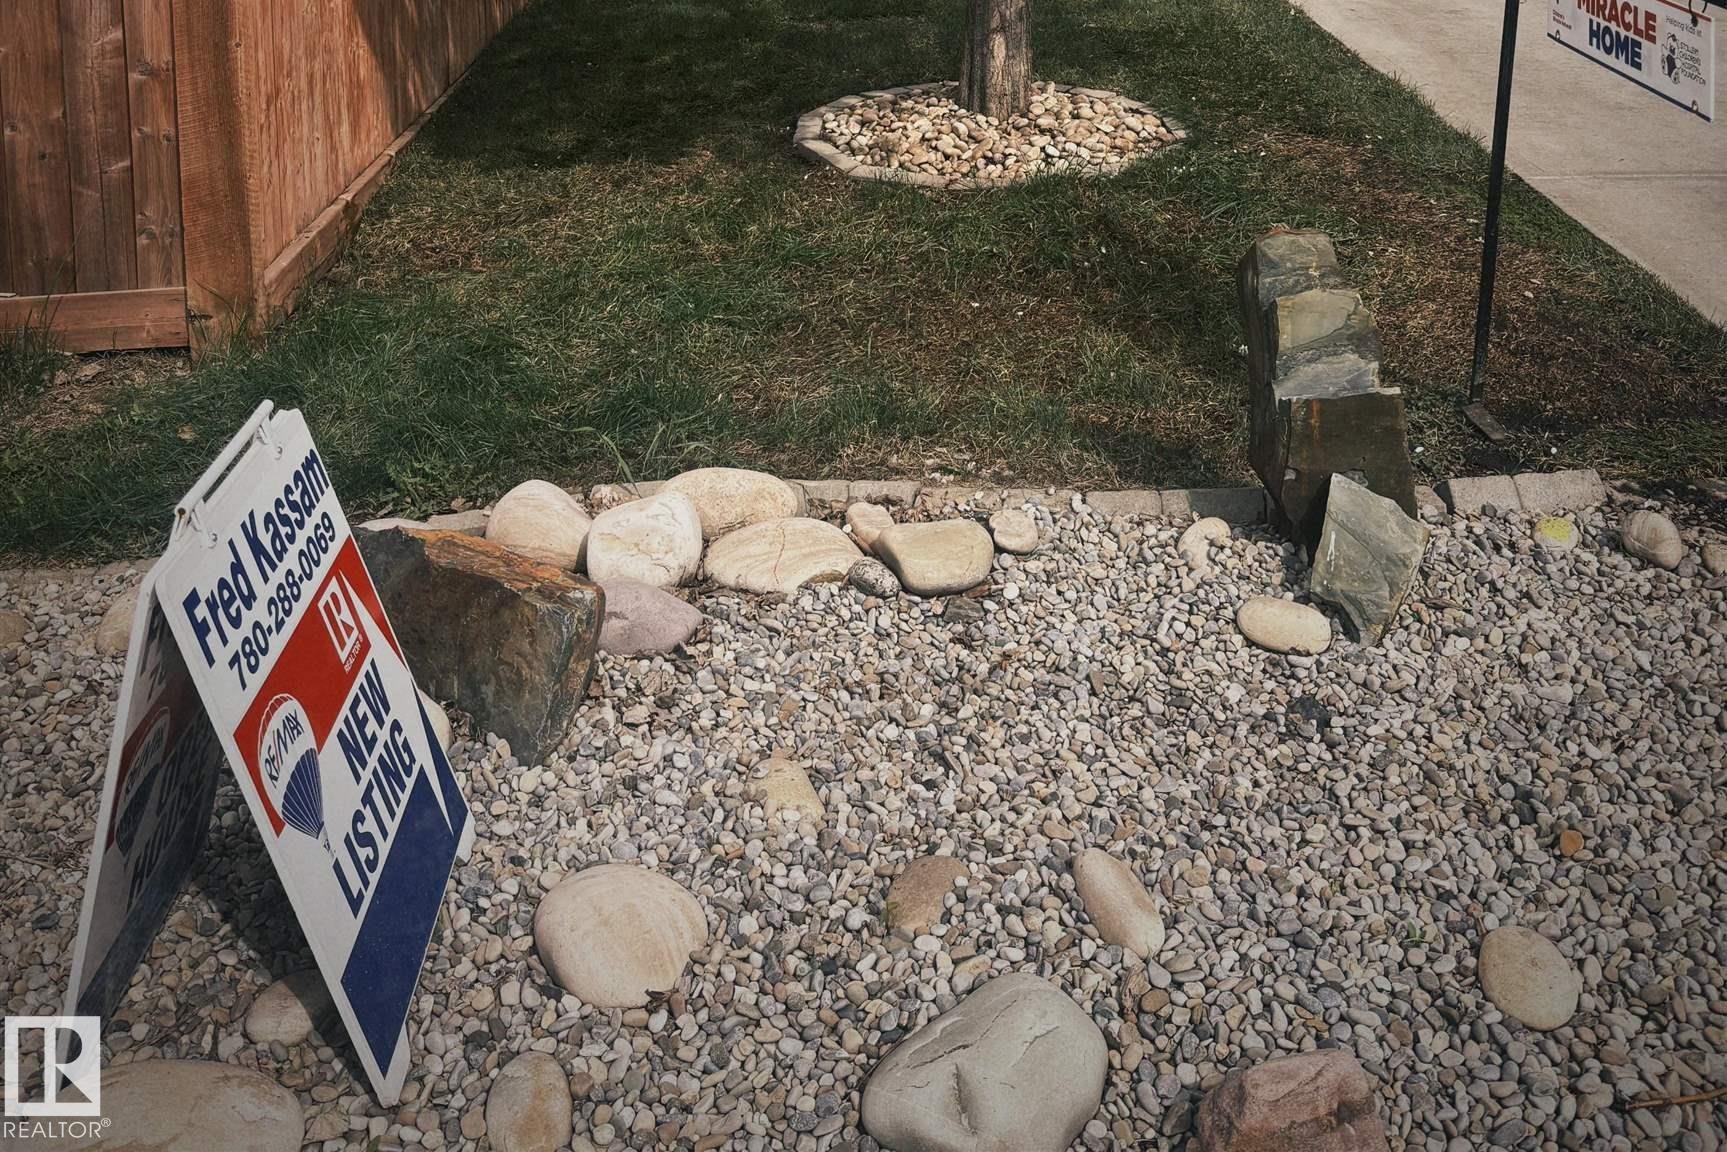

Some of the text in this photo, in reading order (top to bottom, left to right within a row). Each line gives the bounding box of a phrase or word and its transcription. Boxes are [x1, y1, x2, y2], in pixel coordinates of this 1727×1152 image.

[1588, 17, 1642, 71] HOME
[182, 448, 330, 669] Fred Kassam
[227, 511, 336, 692] 780-288-0069
[264, 709, 305, 789] RE/MAX
[336, 657, 391, 786] NEW
[332, 718, 417, 920] LISTING
